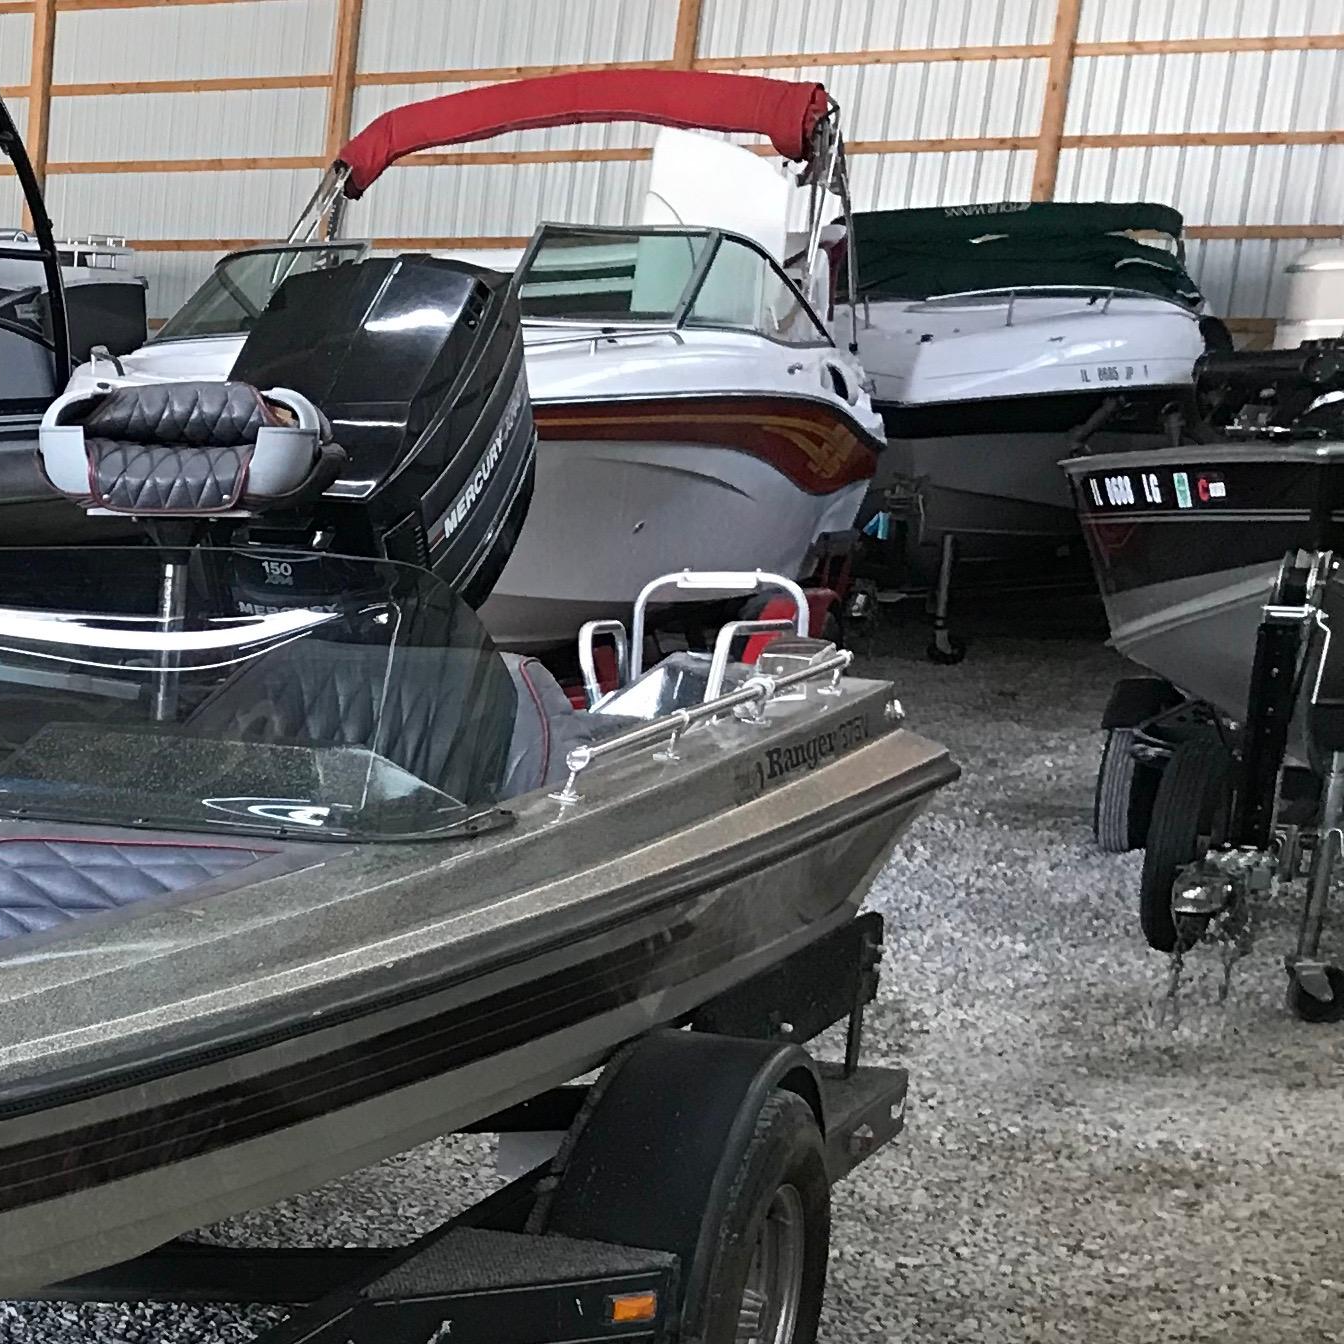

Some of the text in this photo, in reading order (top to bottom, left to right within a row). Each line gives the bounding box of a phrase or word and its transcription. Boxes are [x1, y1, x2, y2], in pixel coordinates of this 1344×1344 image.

[444, 429, 503, 538] MERCURY
[262, 561, 292, 576] 150
[765, 731, 836, 779] Ranger
